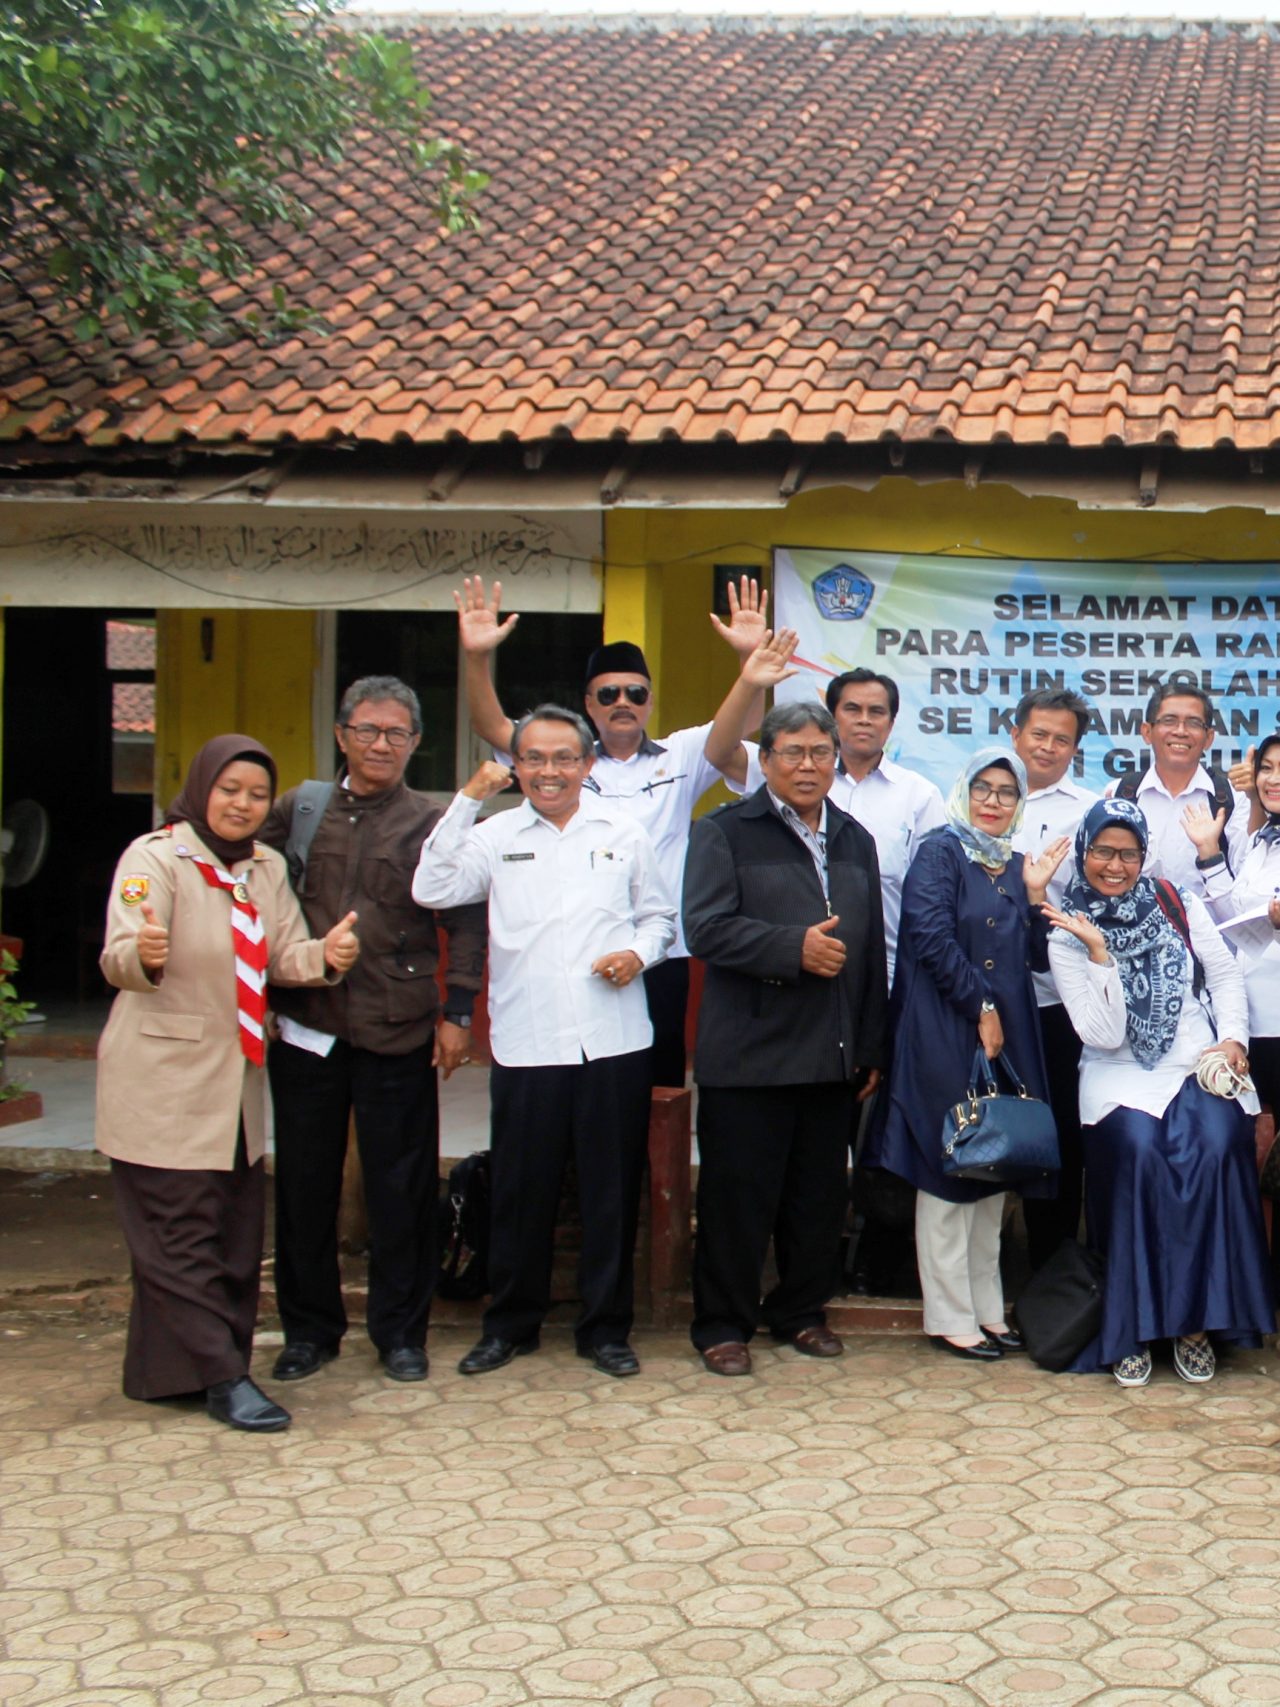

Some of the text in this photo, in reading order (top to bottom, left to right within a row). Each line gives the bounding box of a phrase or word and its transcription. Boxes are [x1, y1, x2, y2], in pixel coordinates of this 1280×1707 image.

[992, 593, 1196, 621] SELAMAT
[875, 628, 990, 656] PARA
[1004, 631, 1200, 659] PESERTA
[930, 667, 1064, 696] RUTIN
[918, 707, 973, 735] SE
[988, 707, 1259, 736] KAMAN
